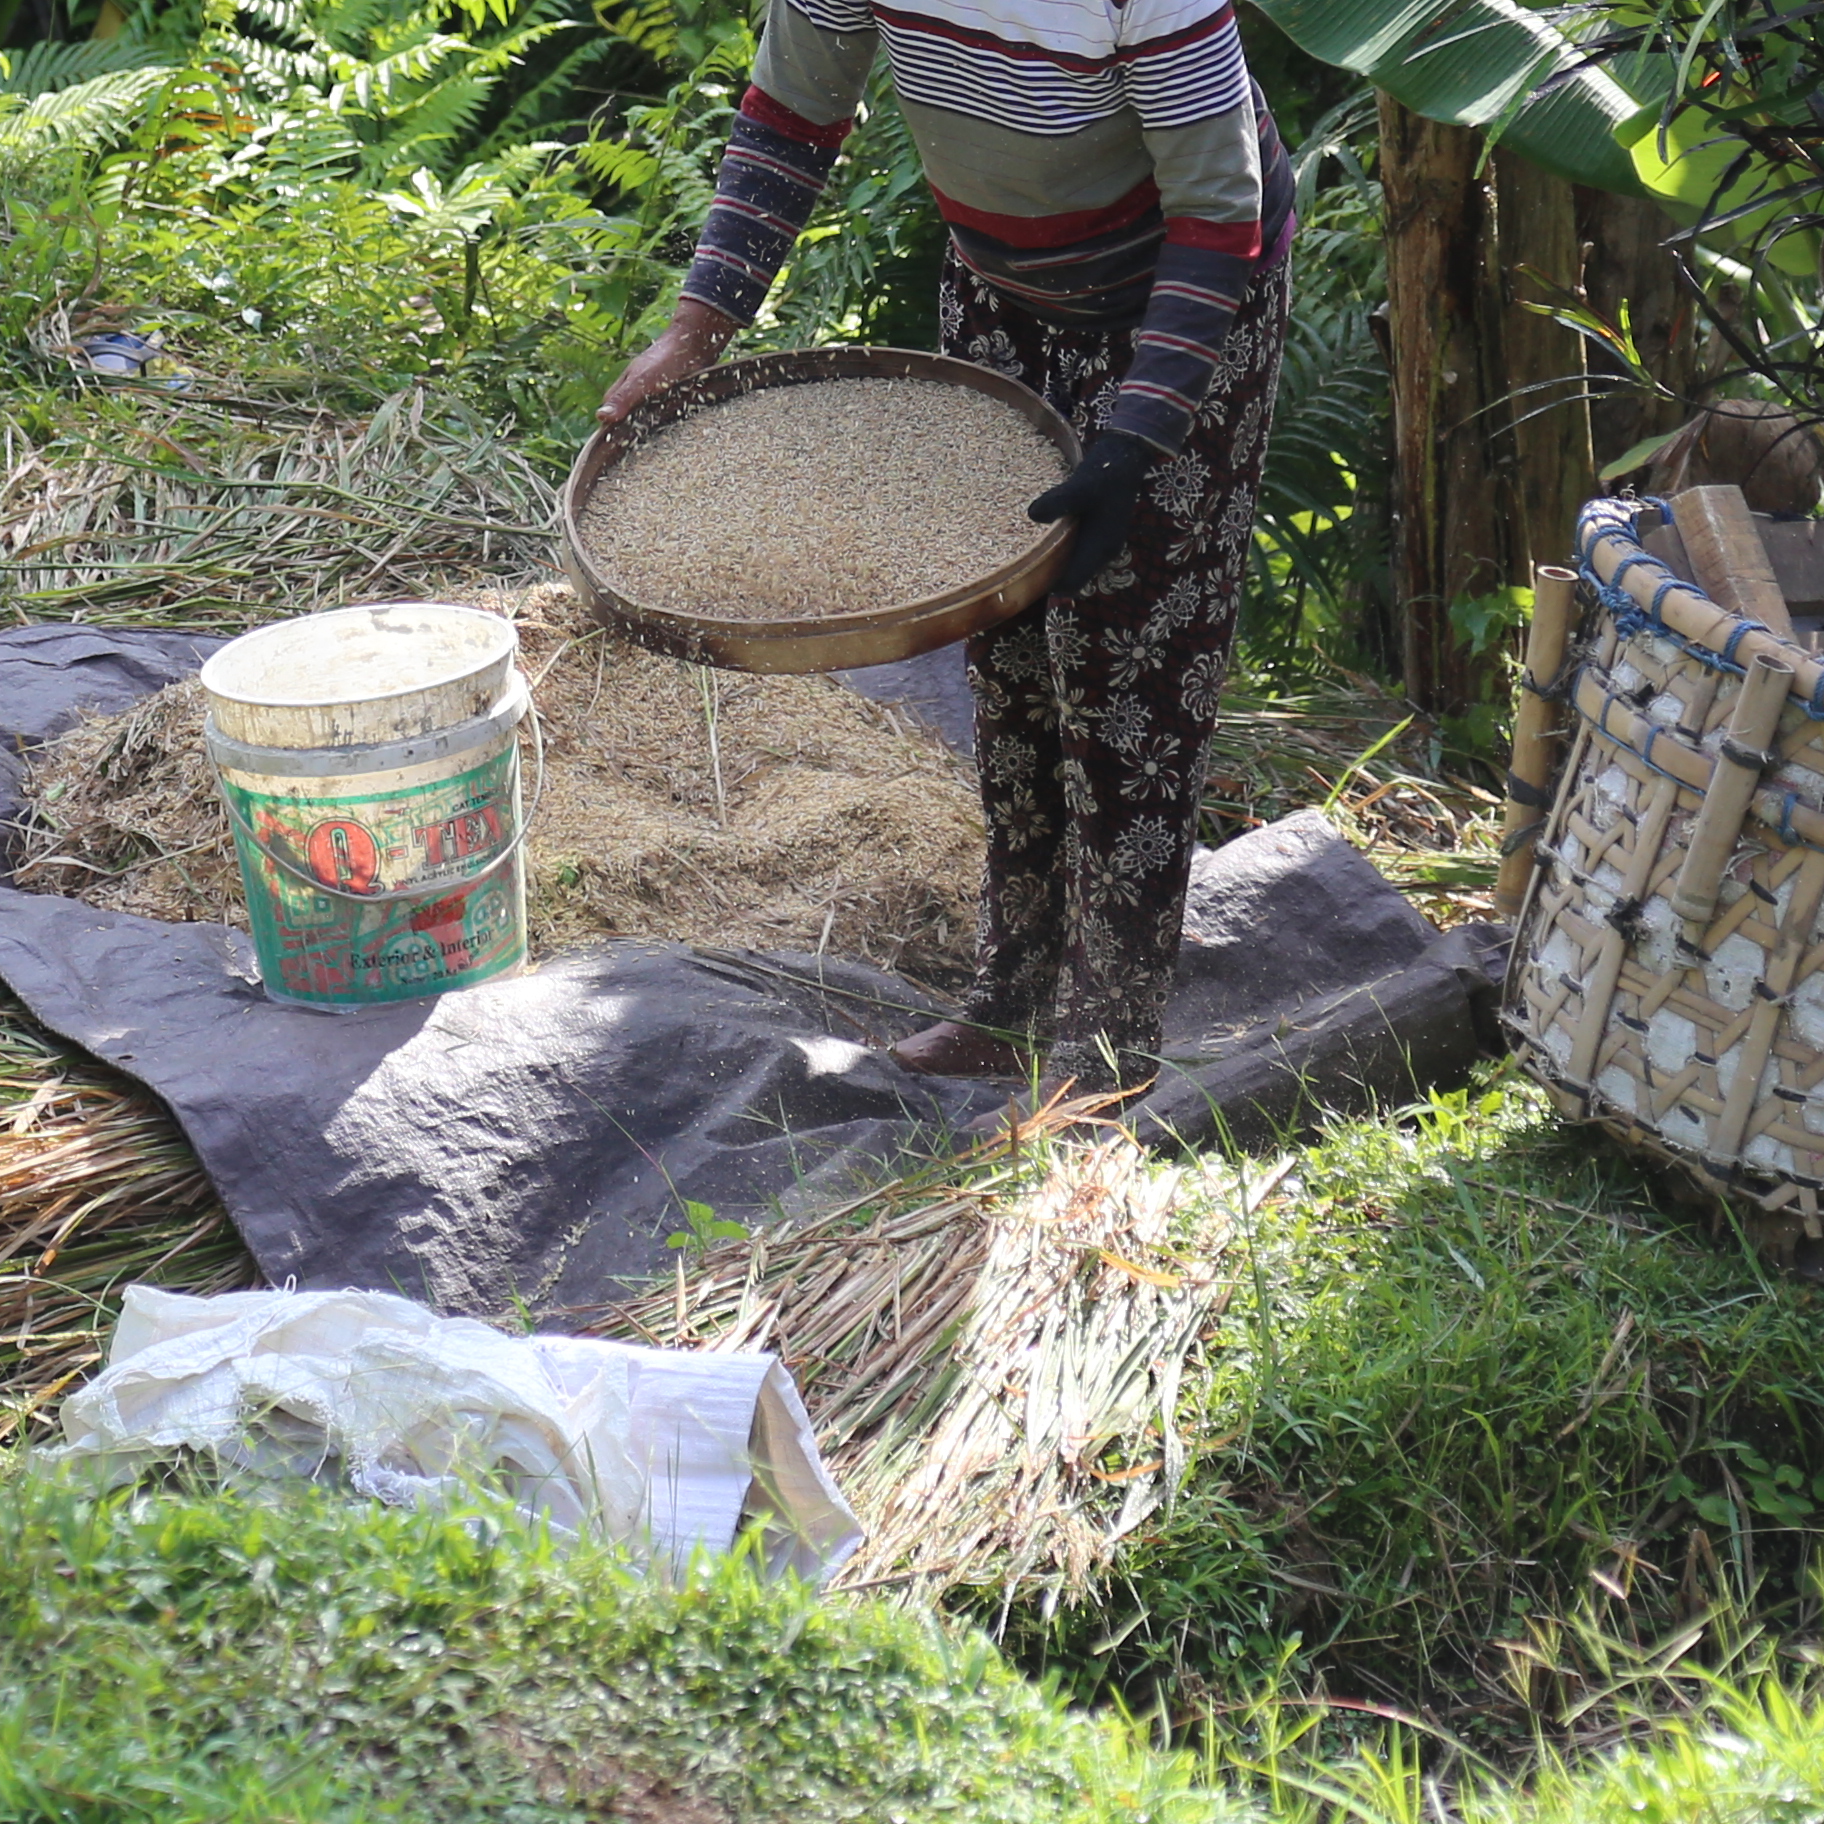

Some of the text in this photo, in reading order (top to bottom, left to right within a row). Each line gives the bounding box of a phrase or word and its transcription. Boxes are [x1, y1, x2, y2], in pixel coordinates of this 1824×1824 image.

[452, 799, 470, 812] CAT
[350, 928, 493, 969] Exterior & Interior
